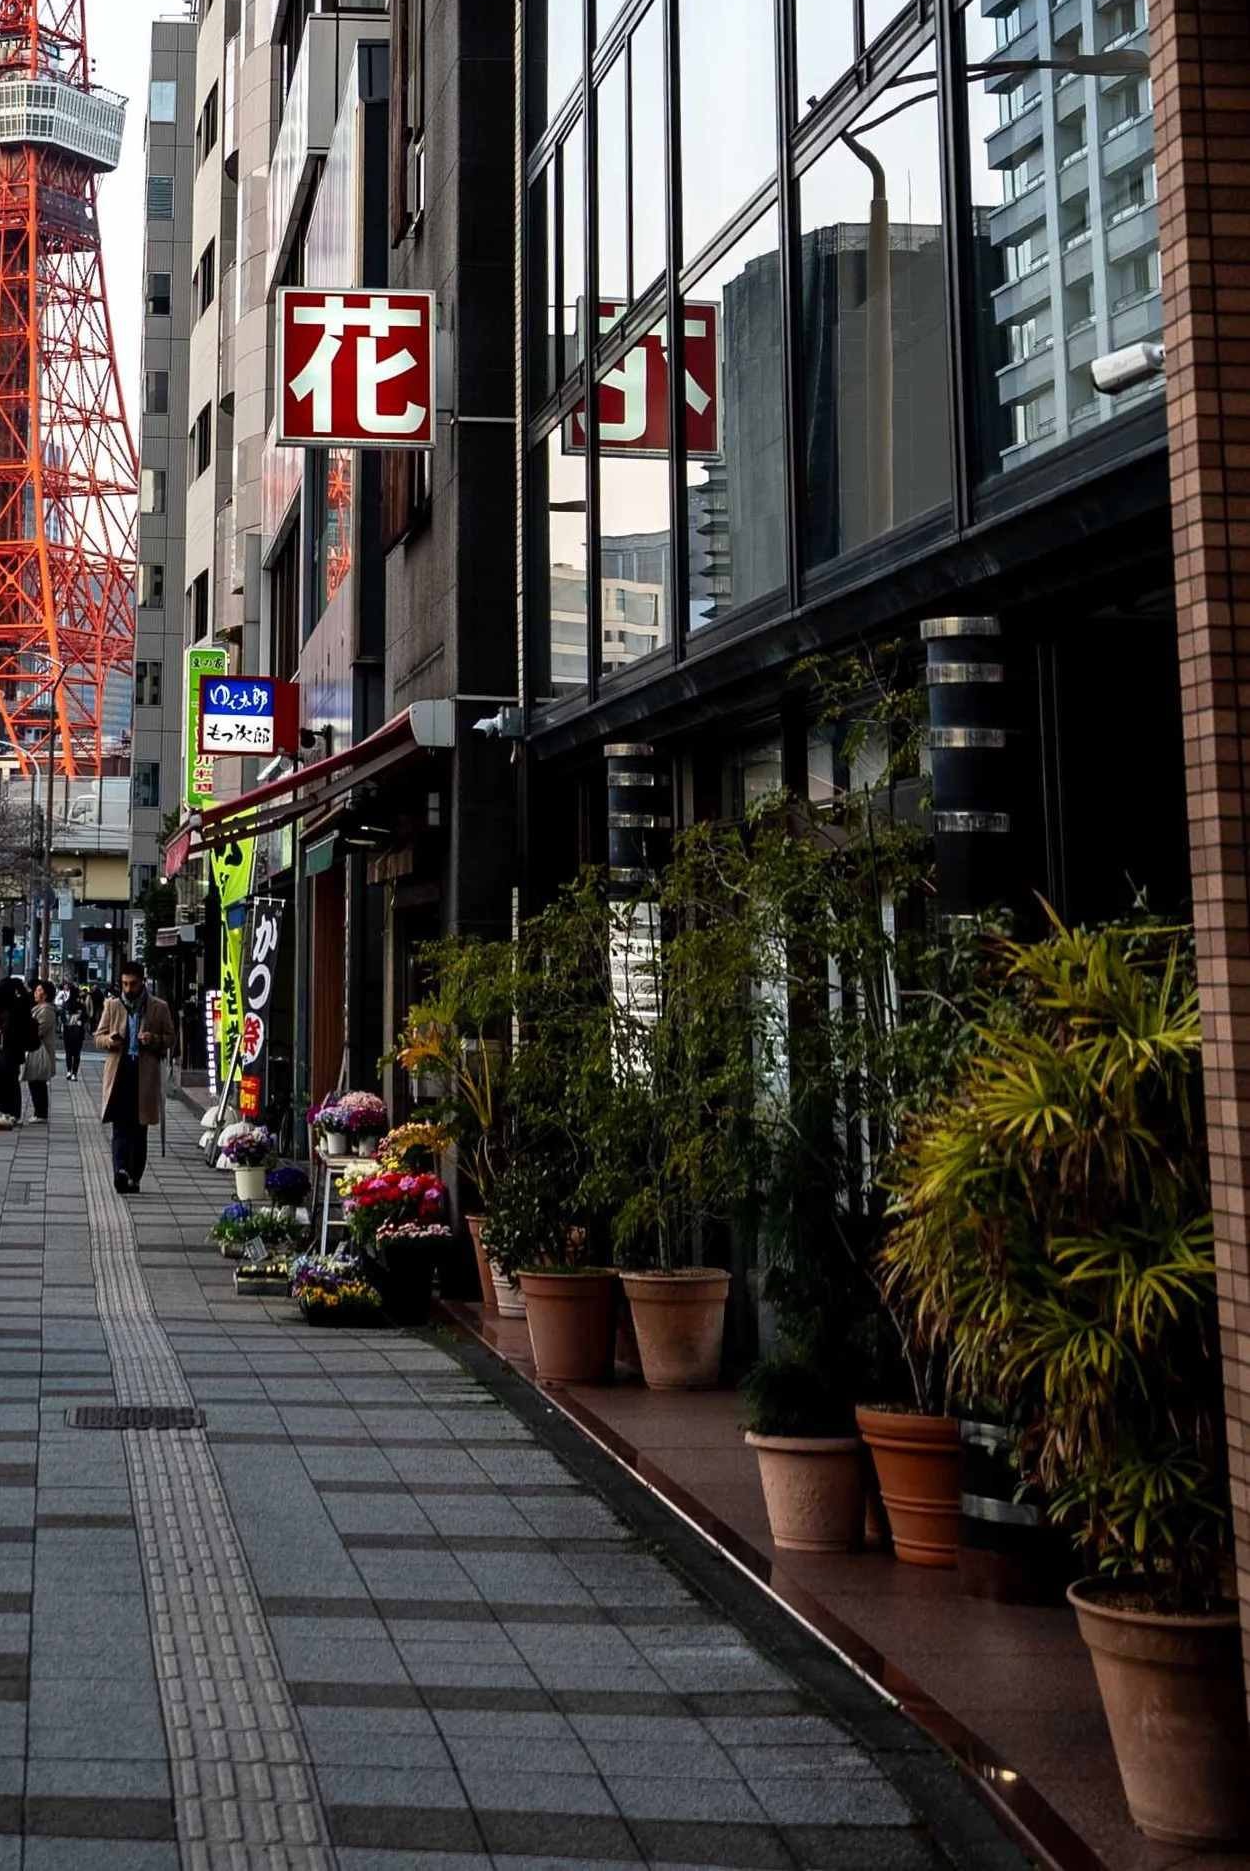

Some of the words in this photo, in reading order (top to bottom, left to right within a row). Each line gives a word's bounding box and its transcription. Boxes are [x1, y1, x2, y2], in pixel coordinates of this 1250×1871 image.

[288, 295, 427, 434] 花
[206, 723, 271, 745] もつ次郎
